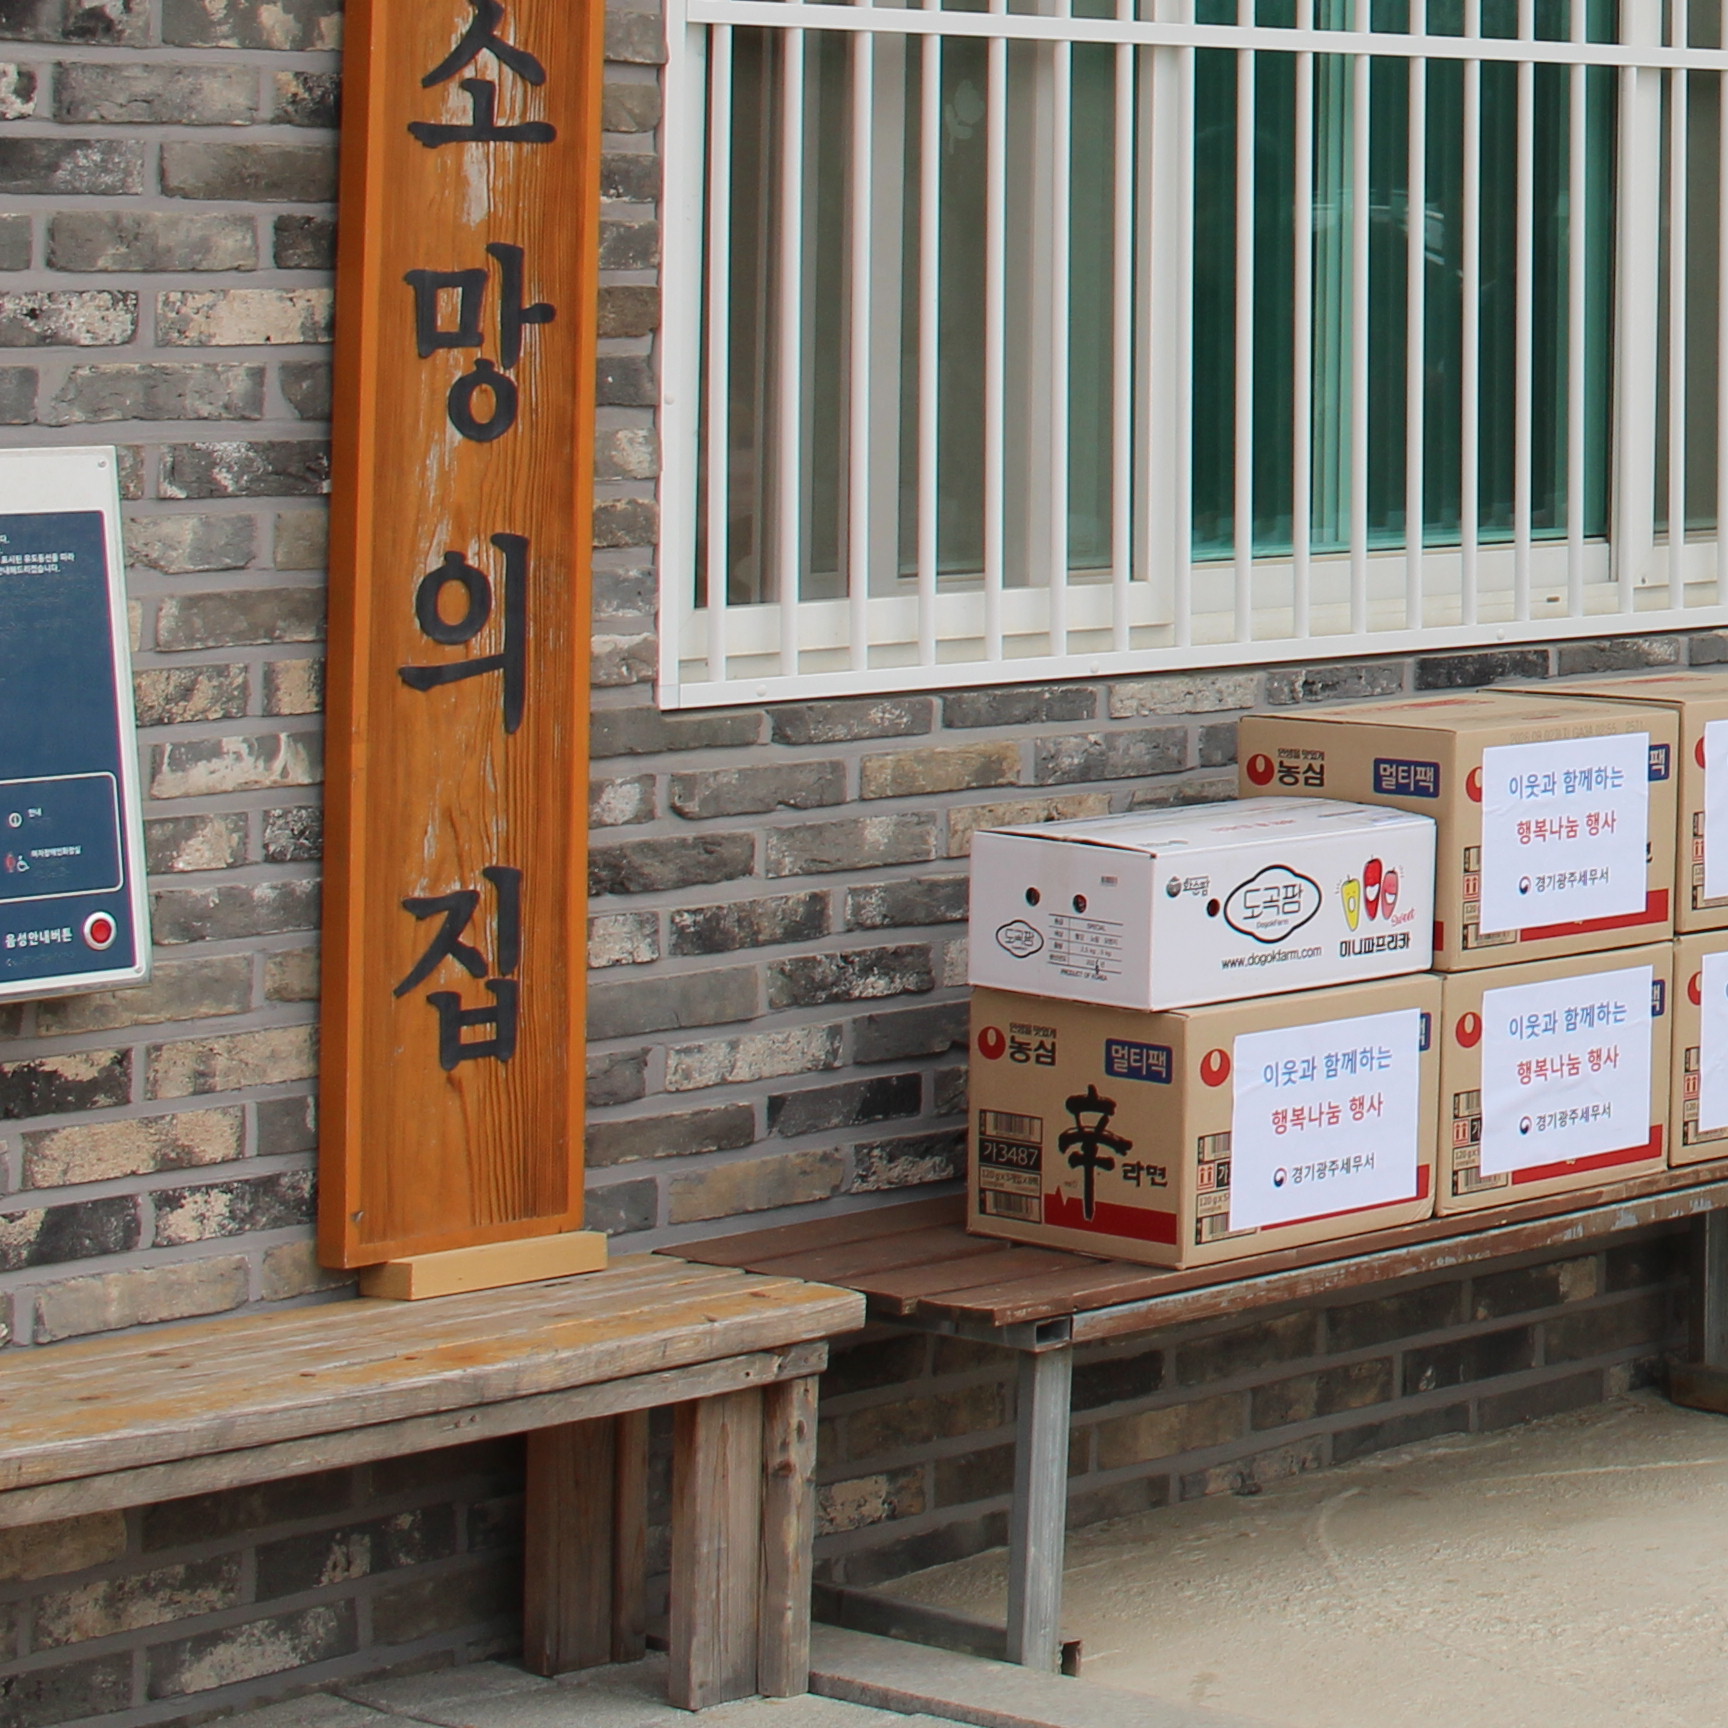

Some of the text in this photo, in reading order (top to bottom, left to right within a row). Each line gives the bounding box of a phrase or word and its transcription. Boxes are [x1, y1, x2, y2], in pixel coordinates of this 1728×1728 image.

[1277, 760, 1325, 788] 농심
[1379, 763, 1434, 793] 멀티팩
[1509, 766, 1624, 799] 이웃과 함께하는
[1516, 810, 1617, 845] 행복나눔 행사
[1535, 867, 1609, 892] 경기광주세무서
[1243, 883, 1303, 920] 도곡팜
[5, 927, 73, 948] 음성안내버튼
[1339, 932, 1411, 958] 미니파프리카
[1221, 946, 1322, 969] www.dogokfarm.com
[1509, 1001, 1627, 1040] 이웃과 함께하는
[1009, 1035, 1056, 1066] 농심
[1111, 1044, 1167, 1078] 멀티팩
[1516, 1045, 1619, 1085] 행복나눔 행사
[1263, 1046, 1392, 1087] 이웃과 함께하는
[1271, 1092, 1384, 1135] 행복나눔 행사
[1535, 1102, 1611, 1132] 경기광주세무서
[983, 1142, 1039, 1166] 가3487
[1058, 1084, 1133, 1221] 辛
[1121, 1161, 1168, 1187] 라면
[1291, 1153, 1375, 1184] 경기광주세무서
